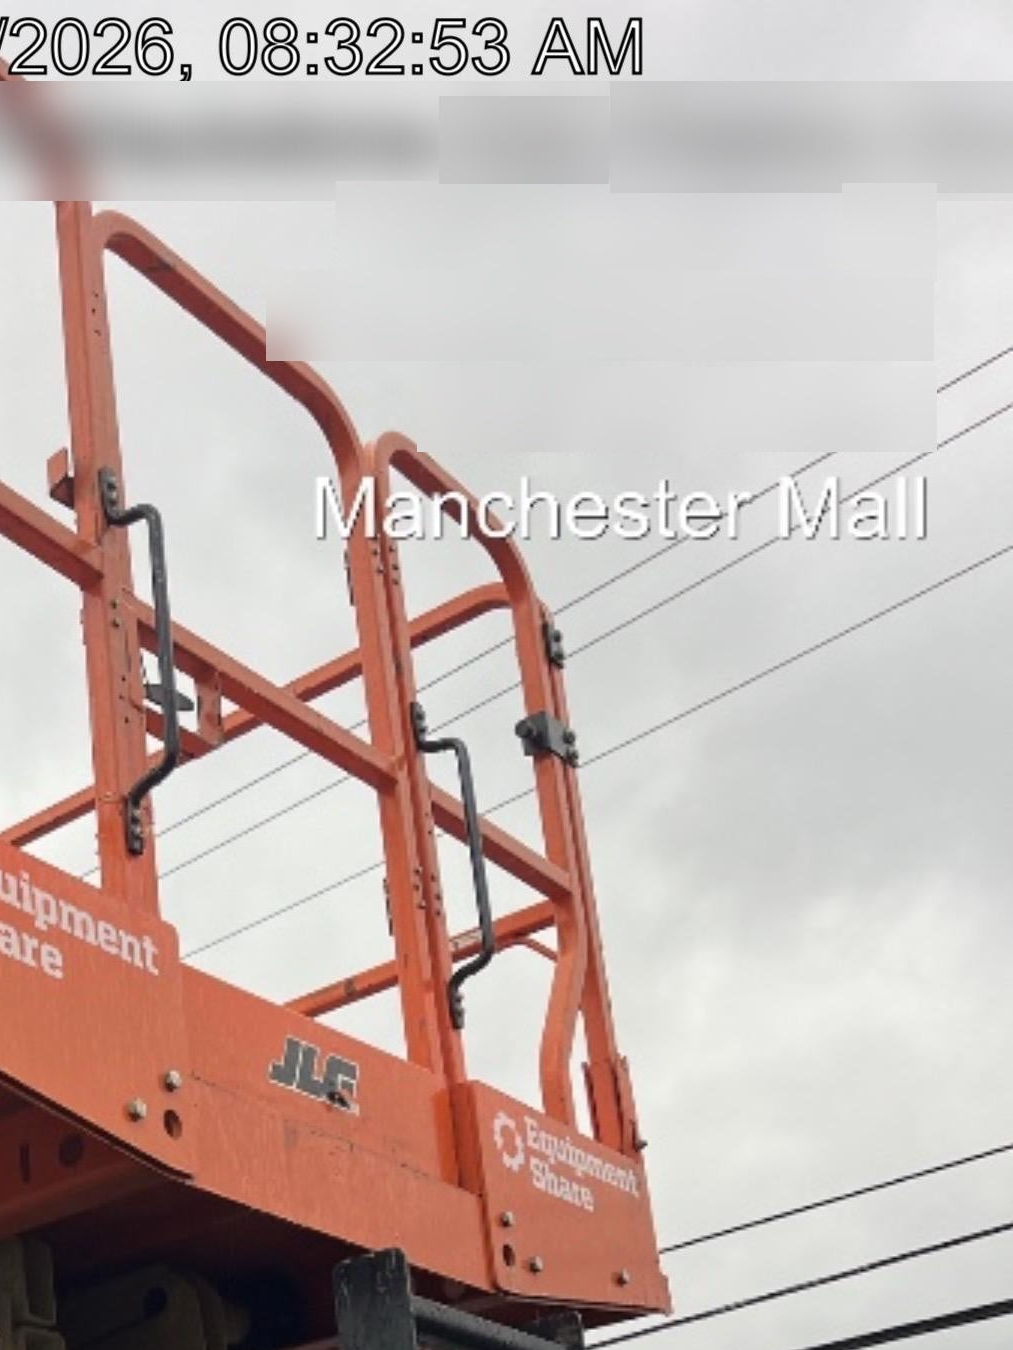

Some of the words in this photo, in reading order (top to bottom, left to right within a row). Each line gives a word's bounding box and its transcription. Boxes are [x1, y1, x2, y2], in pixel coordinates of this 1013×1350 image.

[269, 1036, 360, 1117] JLG
[523, 1115, 639, 1198] Equipment
[529, 1156, 595, 1213] Share
